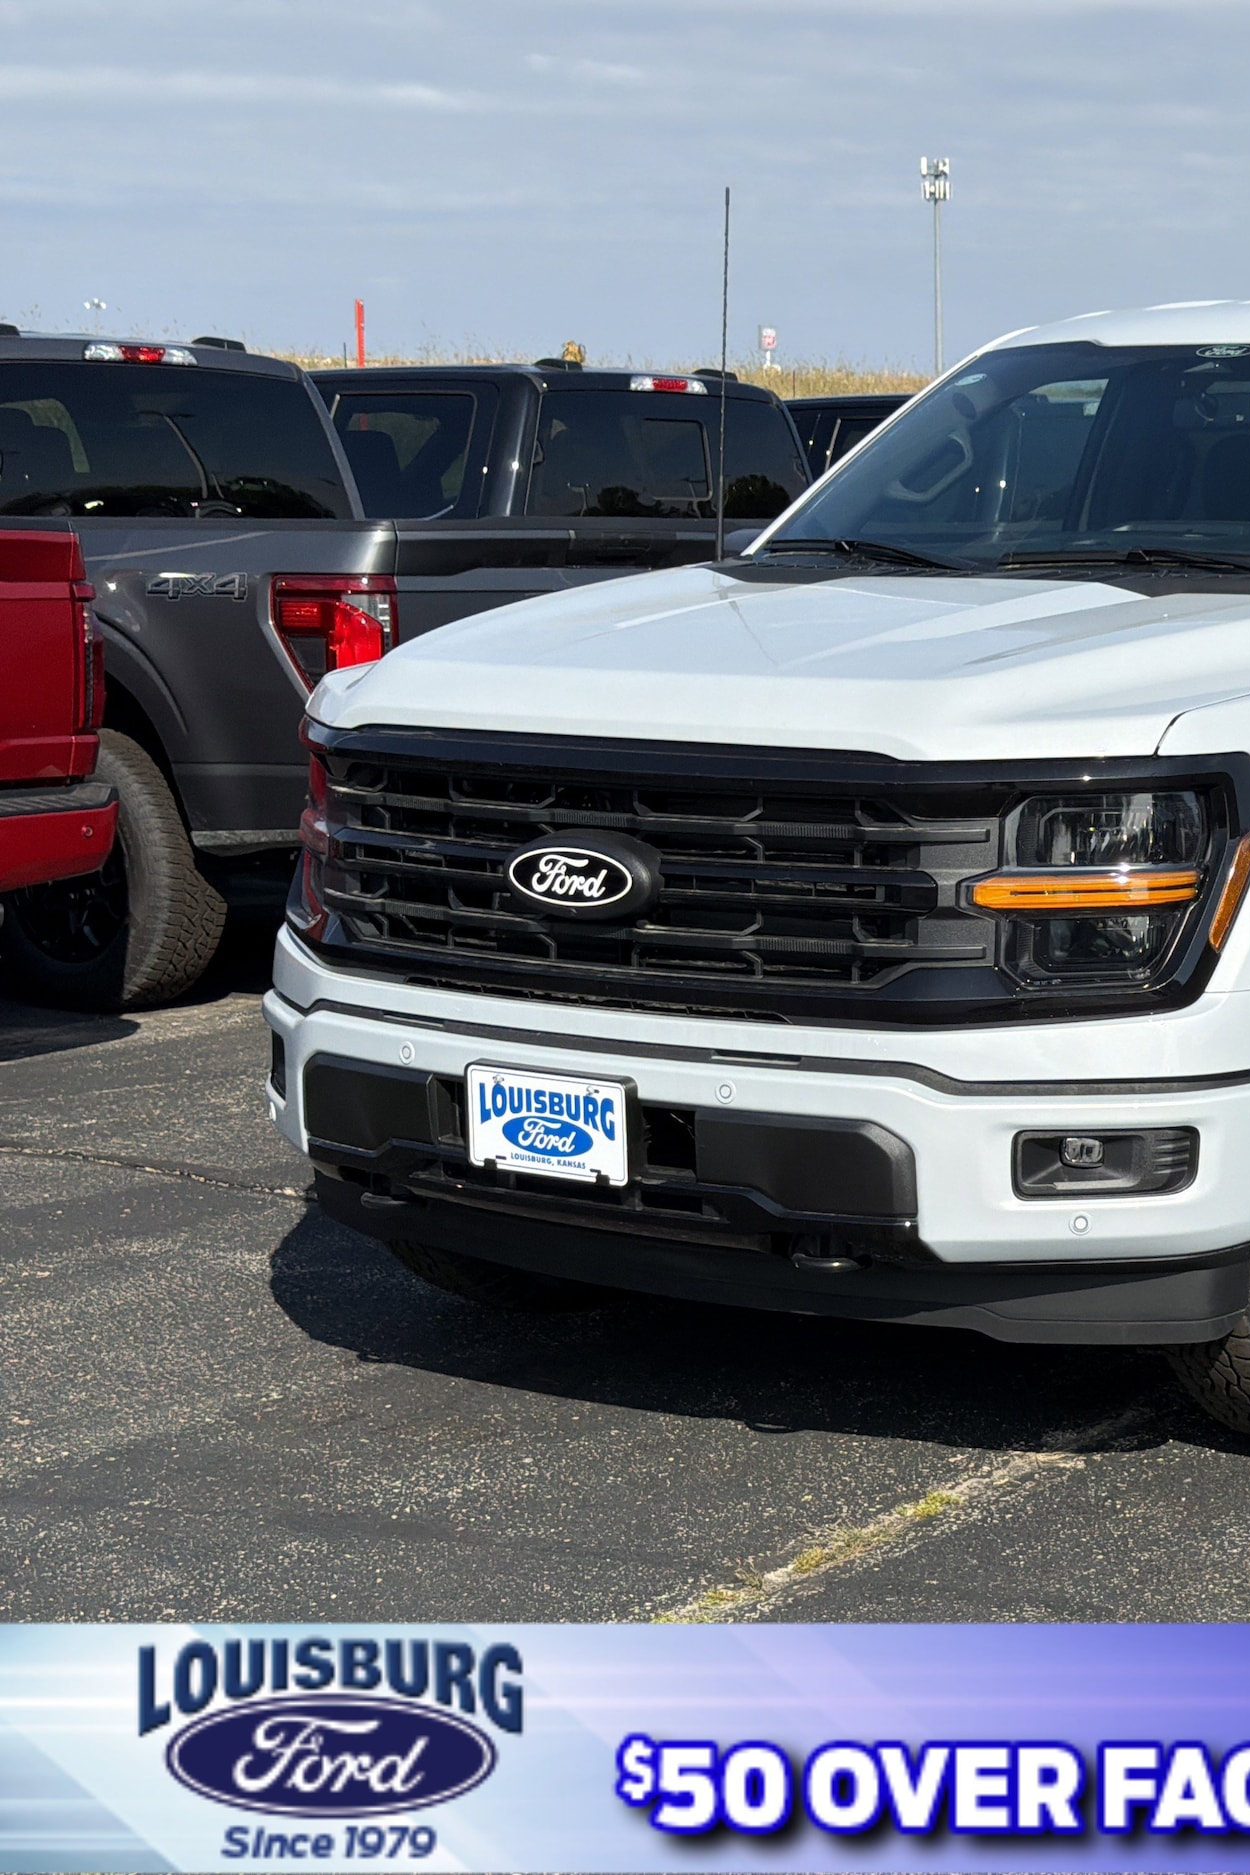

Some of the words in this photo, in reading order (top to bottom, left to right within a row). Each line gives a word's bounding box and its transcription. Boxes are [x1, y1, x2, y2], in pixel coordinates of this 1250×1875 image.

[531, 854, 608, 898] Ford
[479, 1082, 616, 1141] LOUISBURG
[517, 1117, 577, 1153] Ford
[510, 1152, 555, 1167] LOUISBURG,
[557, 1159, 586, 1170] KANSAS
